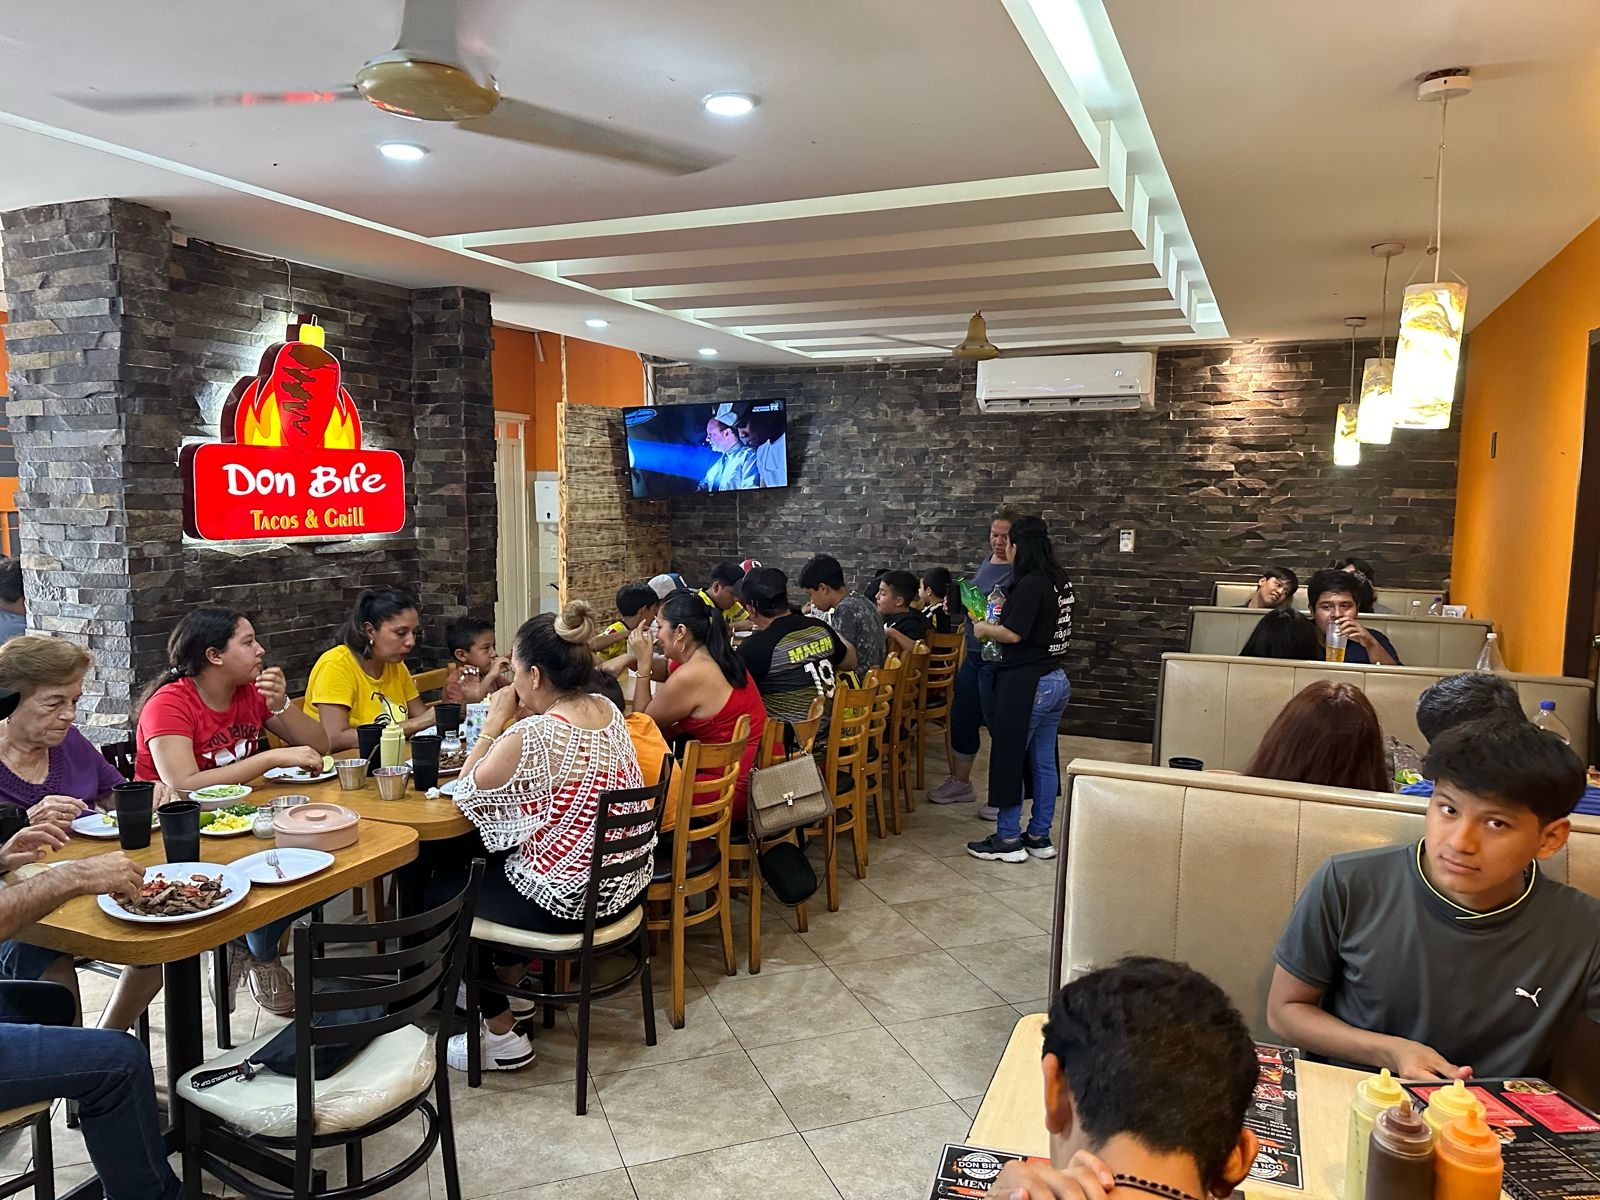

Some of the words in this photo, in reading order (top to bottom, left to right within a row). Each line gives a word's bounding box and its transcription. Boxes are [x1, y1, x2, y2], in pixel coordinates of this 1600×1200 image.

[222, 463, 295, 497] Don
[308, 462, 386, 498] Bife
[304, 508, 318, 528] &
[200, 1079, 210, 1087] CUP
[211, 1073, 228, 1083] WORLD
[1261, 1162, 1283, 1170] DON
